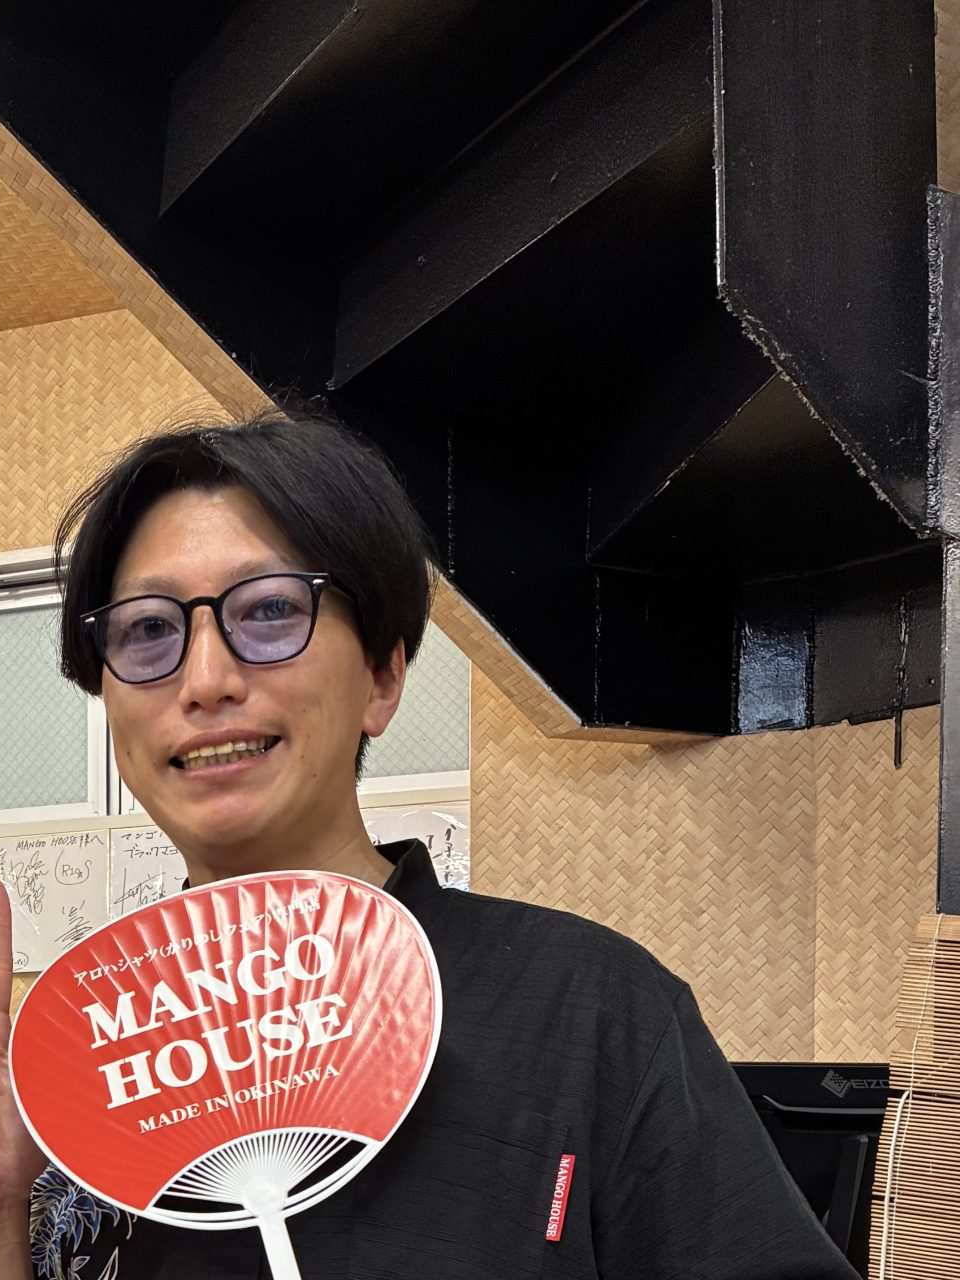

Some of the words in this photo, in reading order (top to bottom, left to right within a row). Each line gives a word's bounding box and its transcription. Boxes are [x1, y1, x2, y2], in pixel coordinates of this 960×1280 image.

[83, 934, 335, 1049] MANGO
[99, 994, 352, 1109] HOUSE
[138, 1103, 201, 1134] MADE
[206, 1093, 233, 1115] IN
[234, 1065, 340, 1104] OKINAWA
[554, 1158, 571, 1198] MANGO
[546, 1200, 562, 1237] HOUSE
